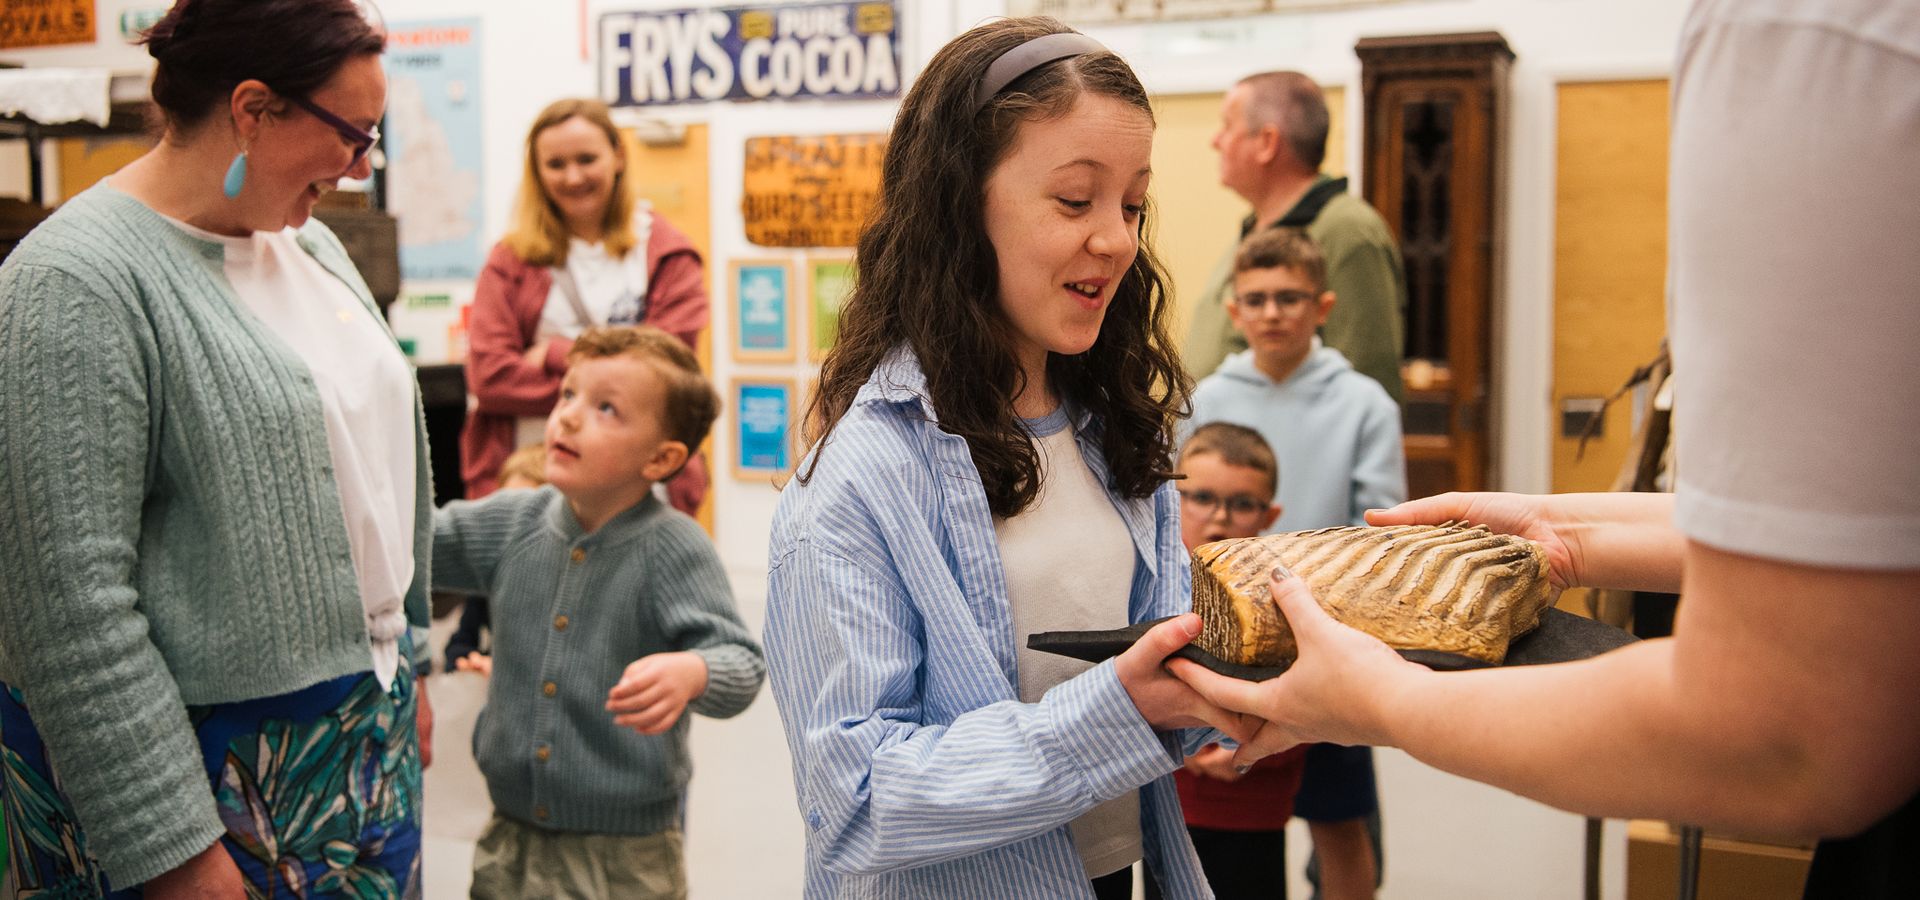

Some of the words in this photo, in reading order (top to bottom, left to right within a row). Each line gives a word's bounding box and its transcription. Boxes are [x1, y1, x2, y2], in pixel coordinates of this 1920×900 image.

[777, 7, 850, 38] PURE
[601, 12, 735, 104] FRYS
[740, 33, 898, 97] COCOA
